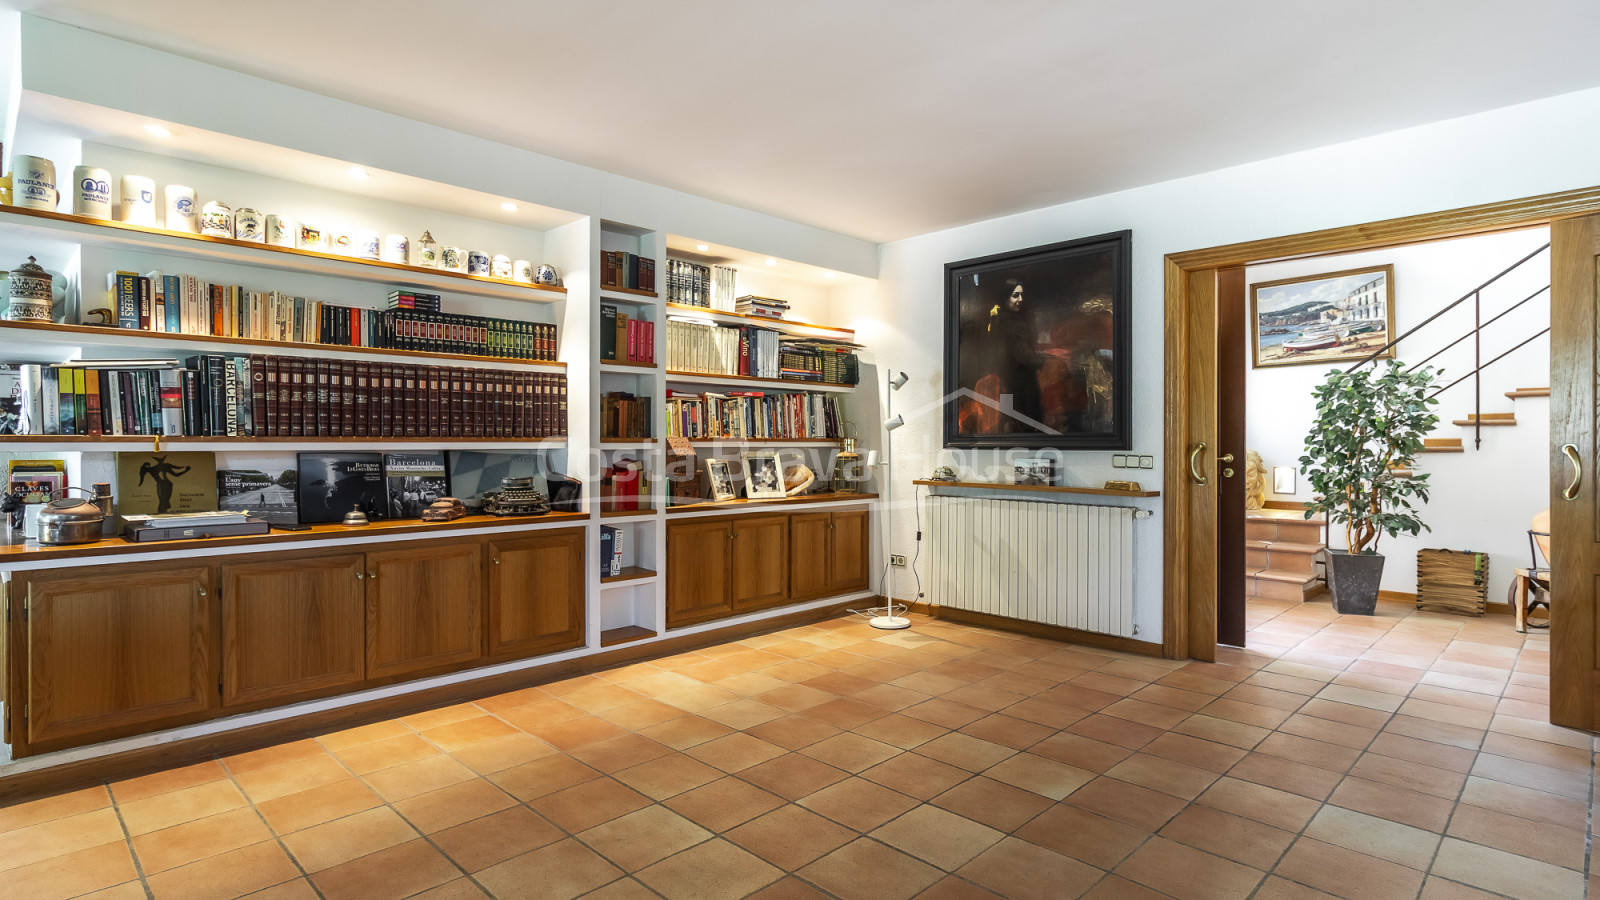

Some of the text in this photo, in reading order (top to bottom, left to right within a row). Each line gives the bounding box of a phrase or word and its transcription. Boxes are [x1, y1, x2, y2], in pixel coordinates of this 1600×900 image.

[124, 277, 134, 317] 1001 BEERS
[742, 340, 750, 356] Vino
[226, 363, 237, 434] BARCELONA
[389, 458, 436, 466] Barcelona
